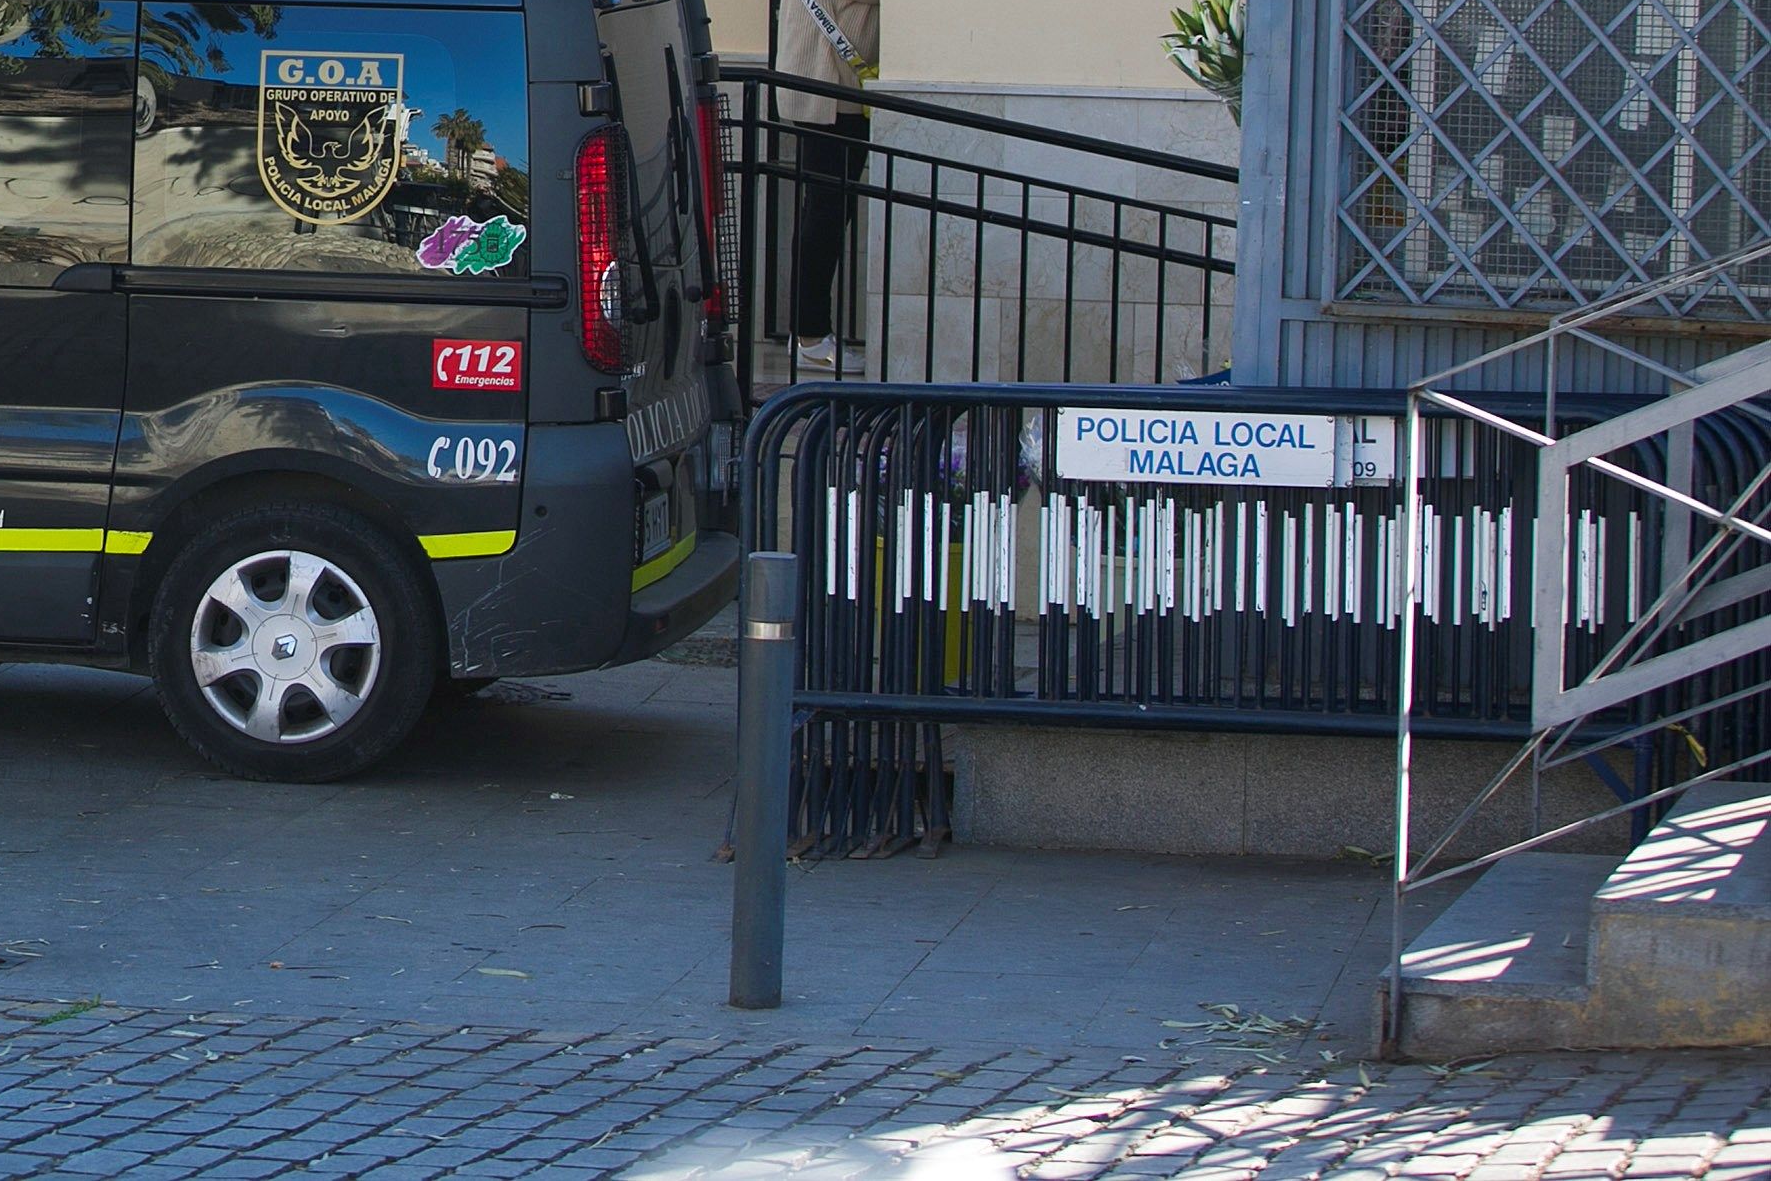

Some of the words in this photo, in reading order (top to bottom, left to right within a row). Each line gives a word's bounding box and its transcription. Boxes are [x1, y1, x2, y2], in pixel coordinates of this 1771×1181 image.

[811, 3, 835, 35] BIMBA
[278, 58, 383, 86] G.O.A
[266, 88, 308, 102] GRUPO
[310, 89, 377, 103] OPERATIVO
[379, 91, 396, 104] DE
[309, 109, 350, 122] APOYO
[264, 156, 301, 205] POLICIA
[303, 196, 351, 212] LOCAL
[351, 157, 393, 208] MALAGA
[455, 345, 515, 373] 112
[454, 374, 515, 387] Emergencias
[626, 396, 685, 461] OLICIA
[1076, 416, 1199, 445] POLICIA
[1214, 420, 1315, 449] LOCAL
[454, 436, 517, 482] 092
[1128, 449, 1261, 478] MALAGA
